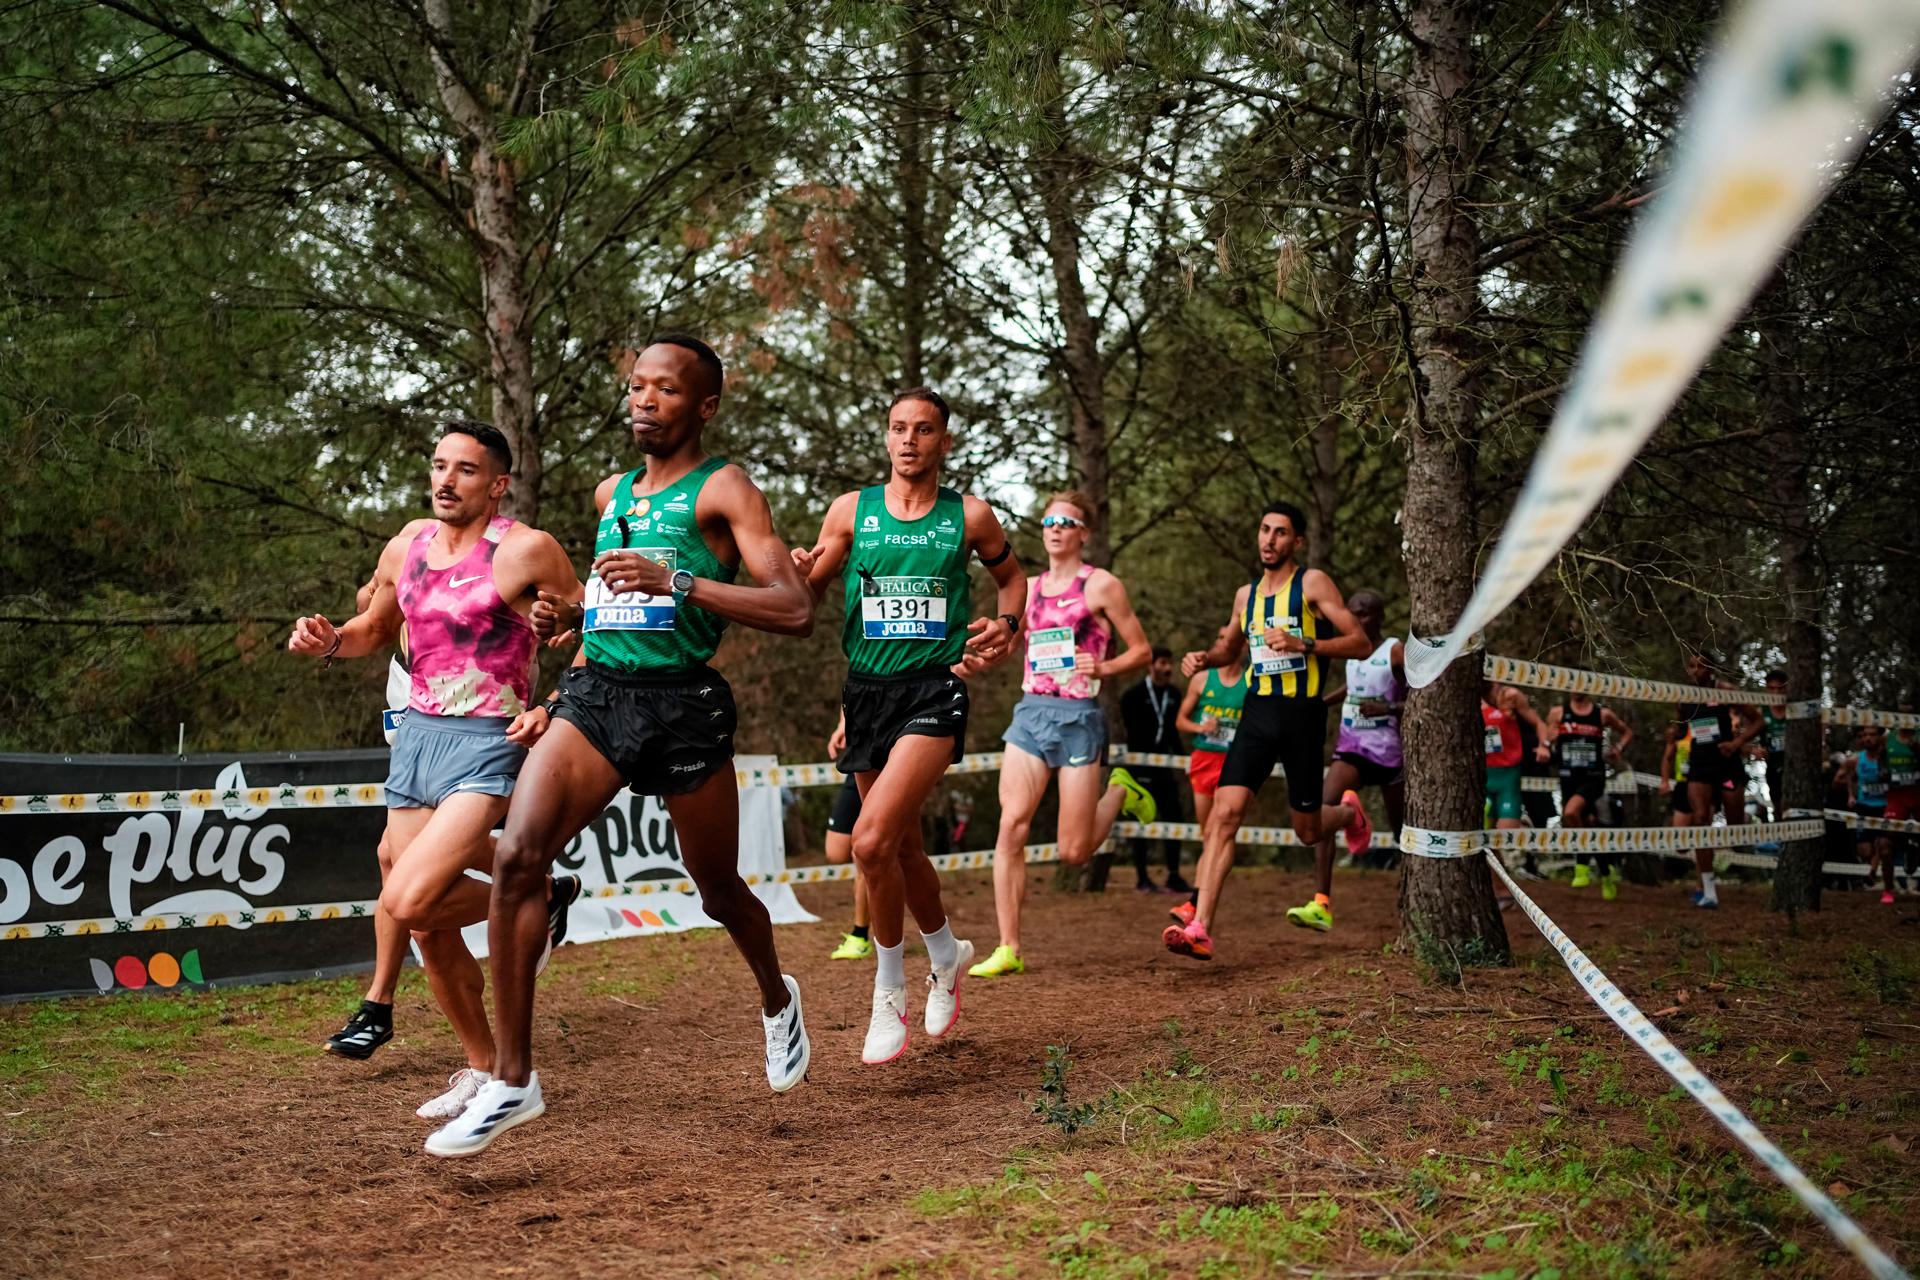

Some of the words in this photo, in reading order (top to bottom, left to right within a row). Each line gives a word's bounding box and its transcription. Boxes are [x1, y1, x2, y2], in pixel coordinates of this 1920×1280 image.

[884, 534, 928, 545] Facsa
[880, 580, 930, 593] ITÁLICA
[877, 599, 930, 619] 1391
[103, 789, 291, 919] plus
